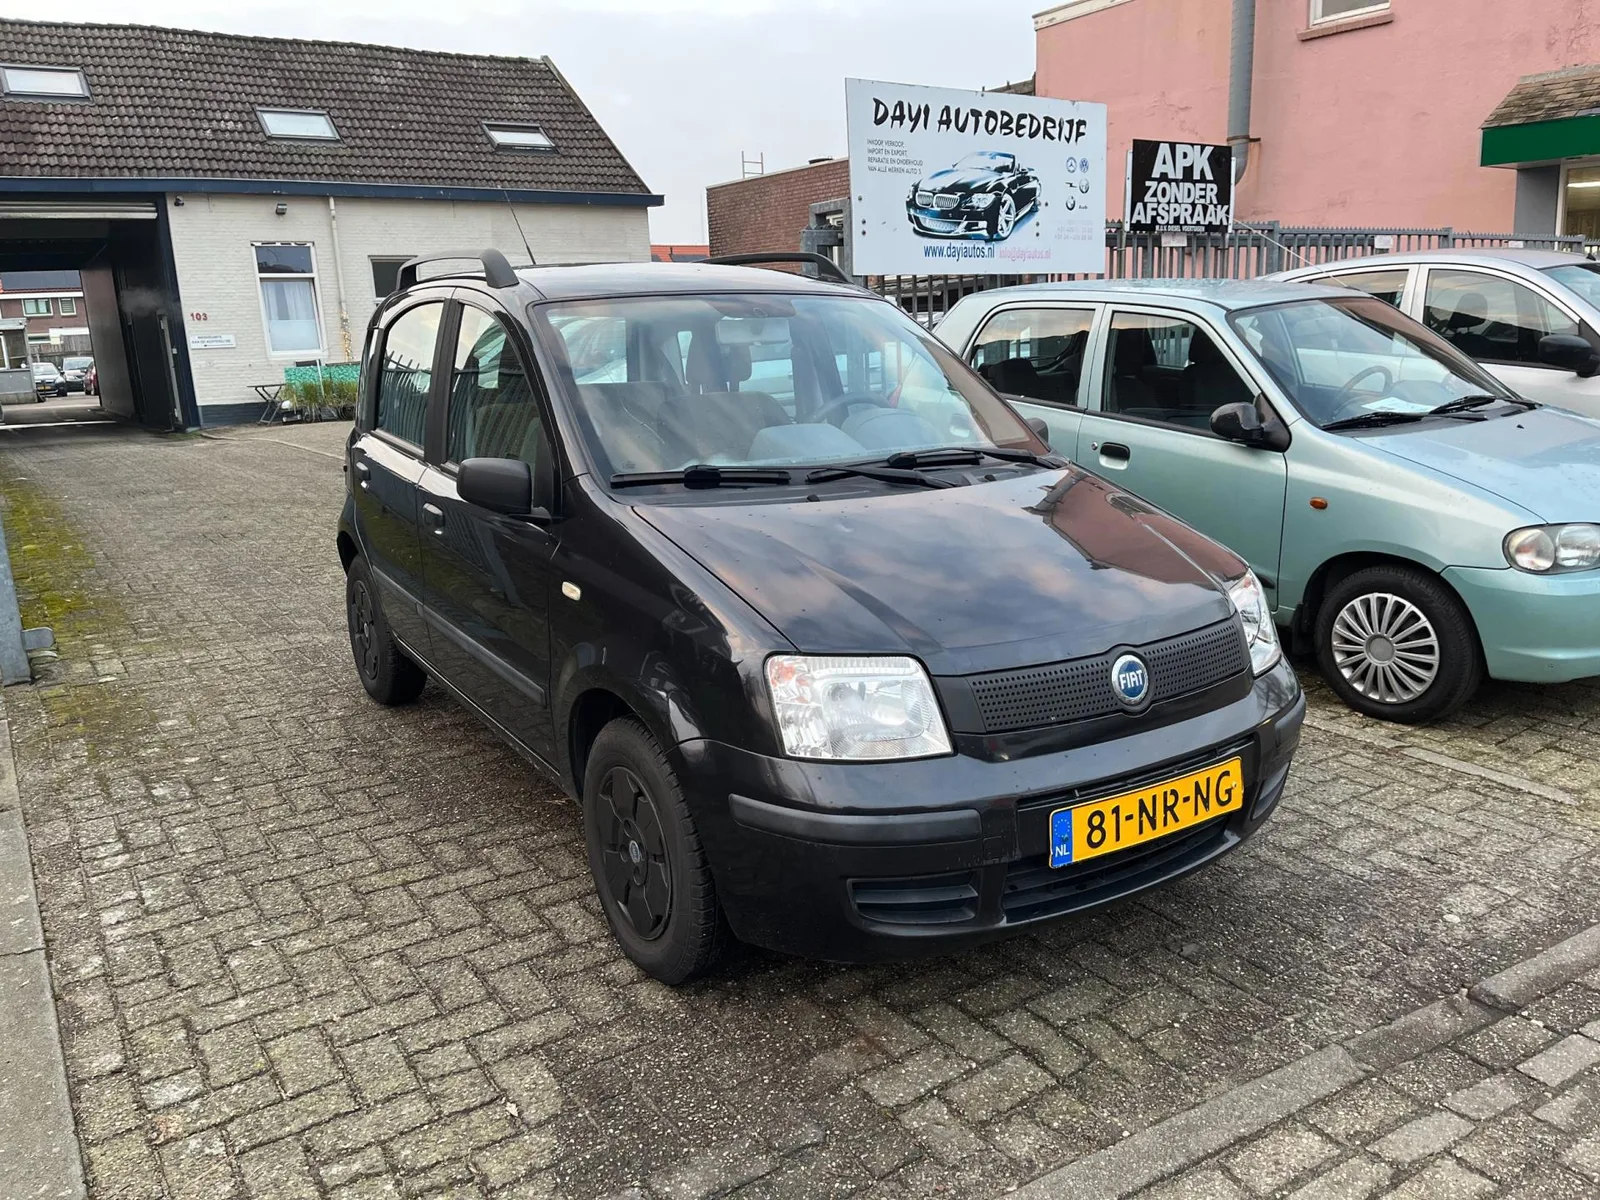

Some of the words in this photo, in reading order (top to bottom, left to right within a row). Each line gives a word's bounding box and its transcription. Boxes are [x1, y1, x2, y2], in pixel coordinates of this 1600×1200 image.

[872, 97, 930, 133] DAYI
[937, 104, 1087, 145] AUTOBEDRIJF
[867, 156, 889, 164] REPARATIE
[897, 158, 923, 167] ONDERHOUD
[1151, 142, 1214, 180] APK
[1144, 181, 1218, 205] ZONDER
[1131, 202, 1229, 226] AFSPRAAK
[923, 242, 995, 262] www.dayiautos.nl
[190, 312, 208, 321] 103
[1118, 670, 1145, 690] FIAT
[1086, 770, 1235, 849] 81-NR-NG
[1055, 843, 1070, 857] NL
